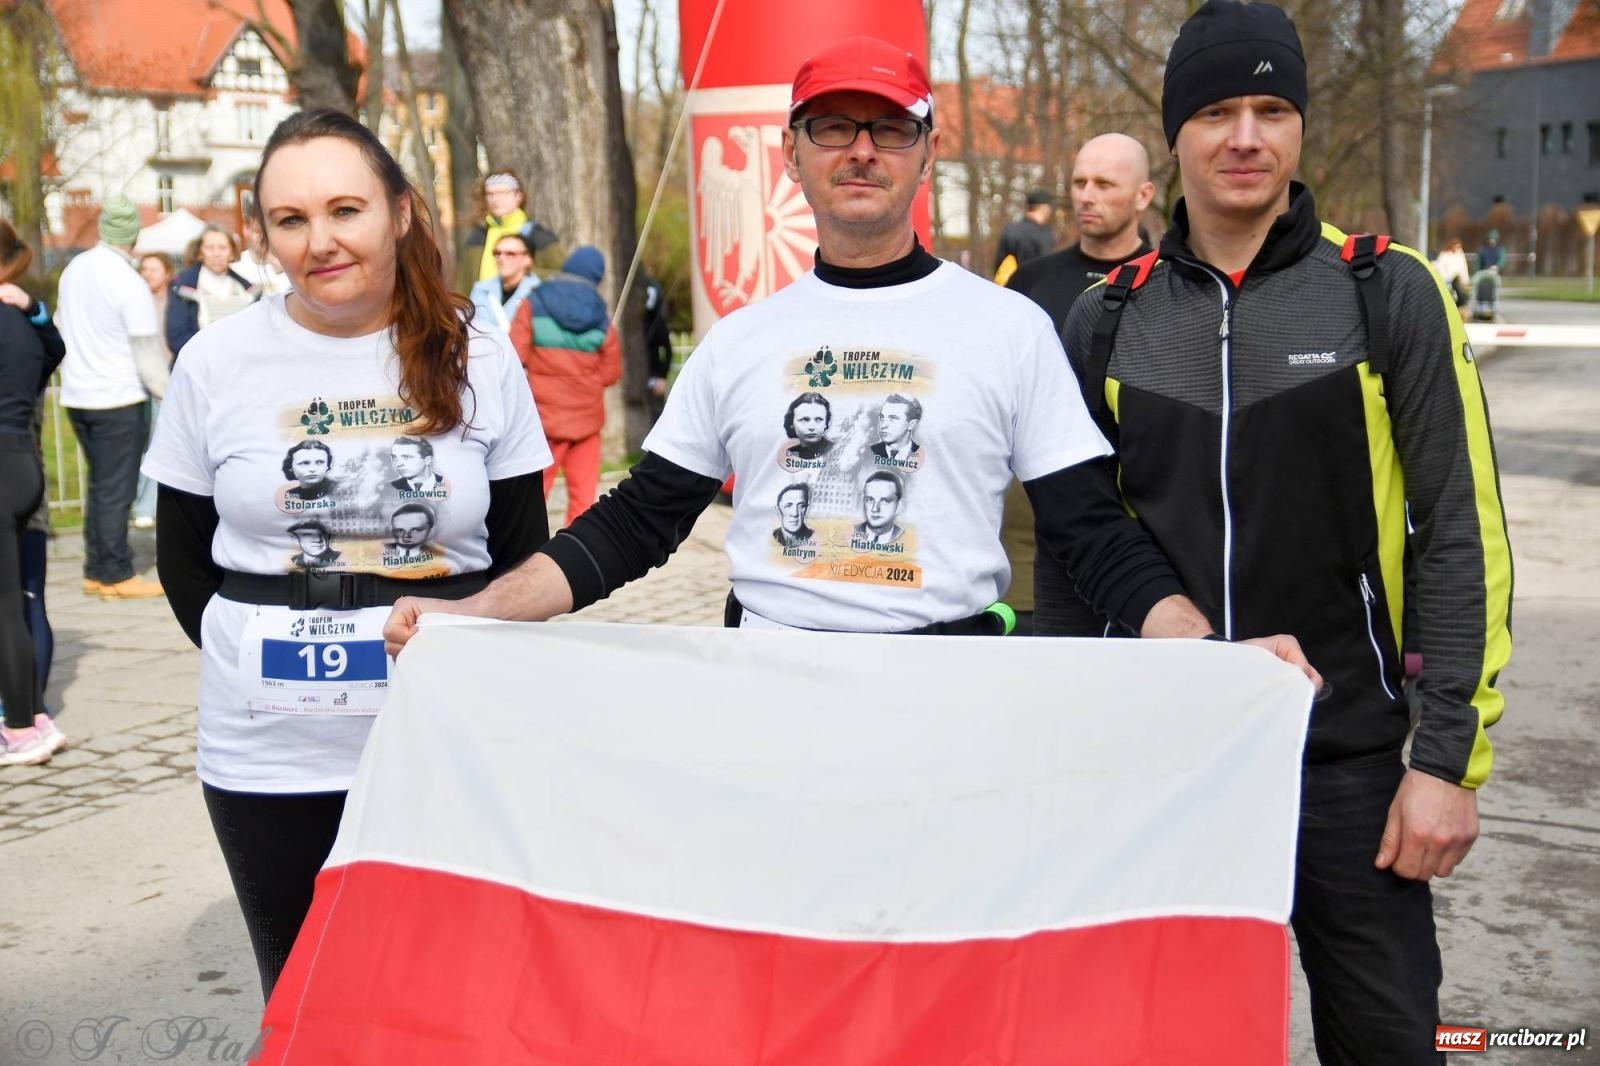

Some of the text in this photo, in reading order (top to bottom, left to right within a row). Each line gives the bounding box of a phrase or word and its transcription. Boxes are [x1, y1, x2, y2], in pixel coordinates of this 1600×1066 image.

[843, 351, 880, 361] TROPEM
[843, 362, 914, 380] WILCZYM
[338, 399, 376, 410] TROPEM
[339, 408, 413, 426] WILCZYM
[786, 458, 826, 469] Stolarska
[874, 456, 919, 469] Rodowicz
[399, 489, 448, 499] Rodowicz
[284, 500, 336, 510] Stolarska
[850, 538, 904, 553] Miatkowski
[382, 551, 434, 566] Miatkowski
[783, 546, 816, 560] Kontrym
[843, 565, 884, 579] EDYCJA
[886, 567, 914, 582] 2024
[309, 623, 355, 635] WILCZYM
[297, 644, 348, 678] 19
